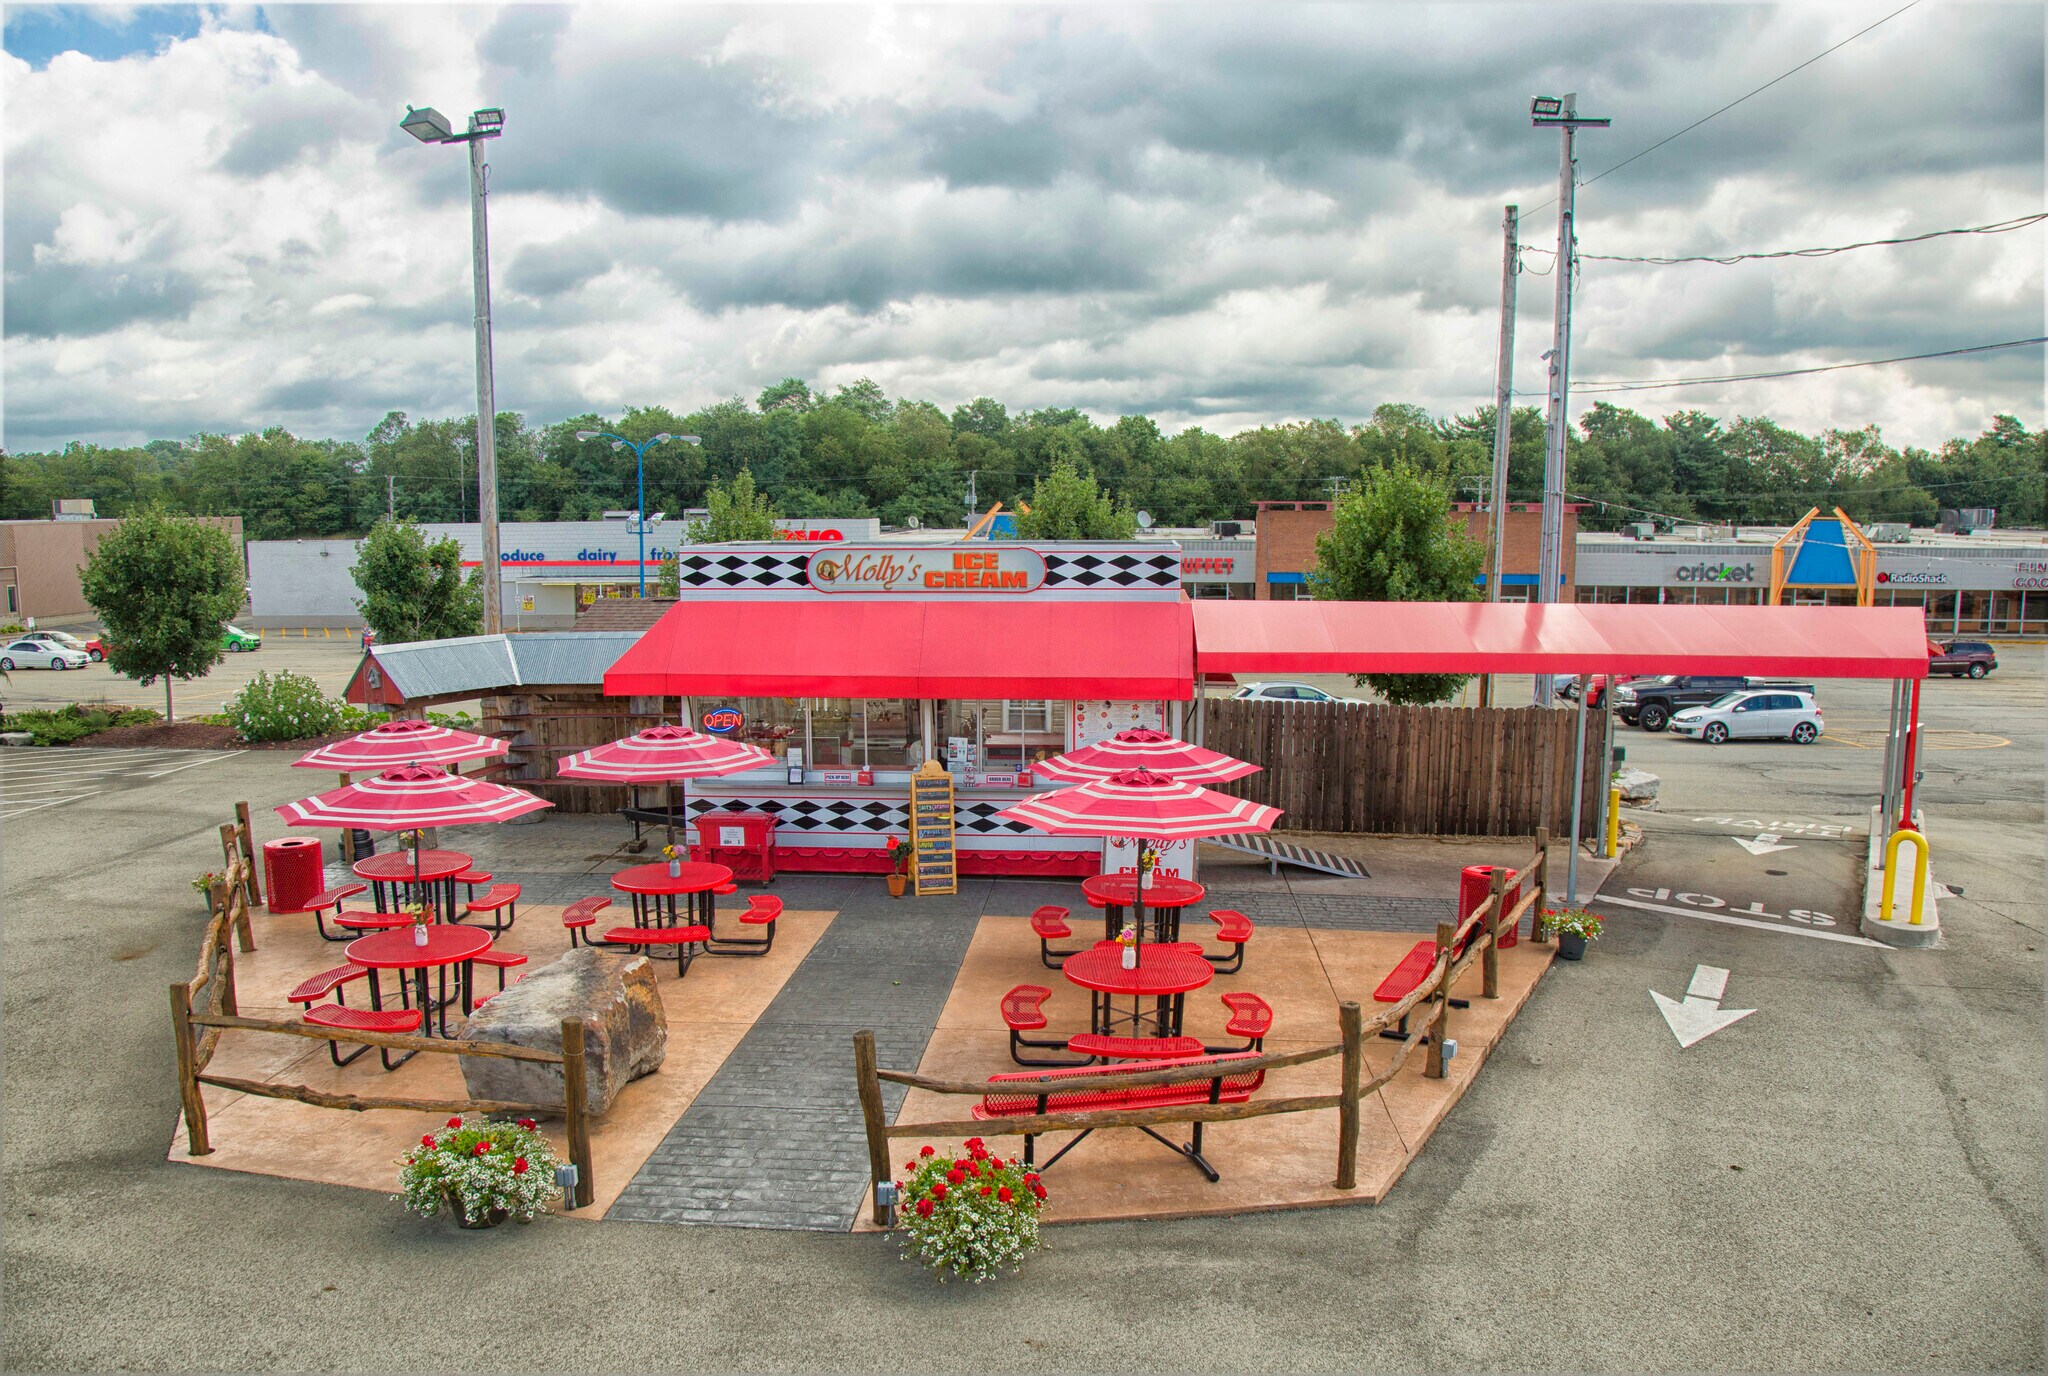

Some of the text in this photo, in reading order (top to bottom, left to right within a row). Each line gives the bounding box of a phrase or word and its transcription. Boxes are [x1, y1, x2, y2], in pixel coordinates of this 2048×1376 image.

[500, 548, 545, 562] oduce
[577, 548, 617, 565] dairy
[952, 552, 999, 570] ICE
[830, 553, 922, 590] Molly's
[1183, 557, 1233, 575] UFFET
[1676, 562, 1754, 581] cricket
[923, 571, 1028, 588] CREAM
[1889, 572, 1947, 583] RadioShack
[703, 713, 742, 727] OPEN
[1627, 887, 1837, 926] STOP
